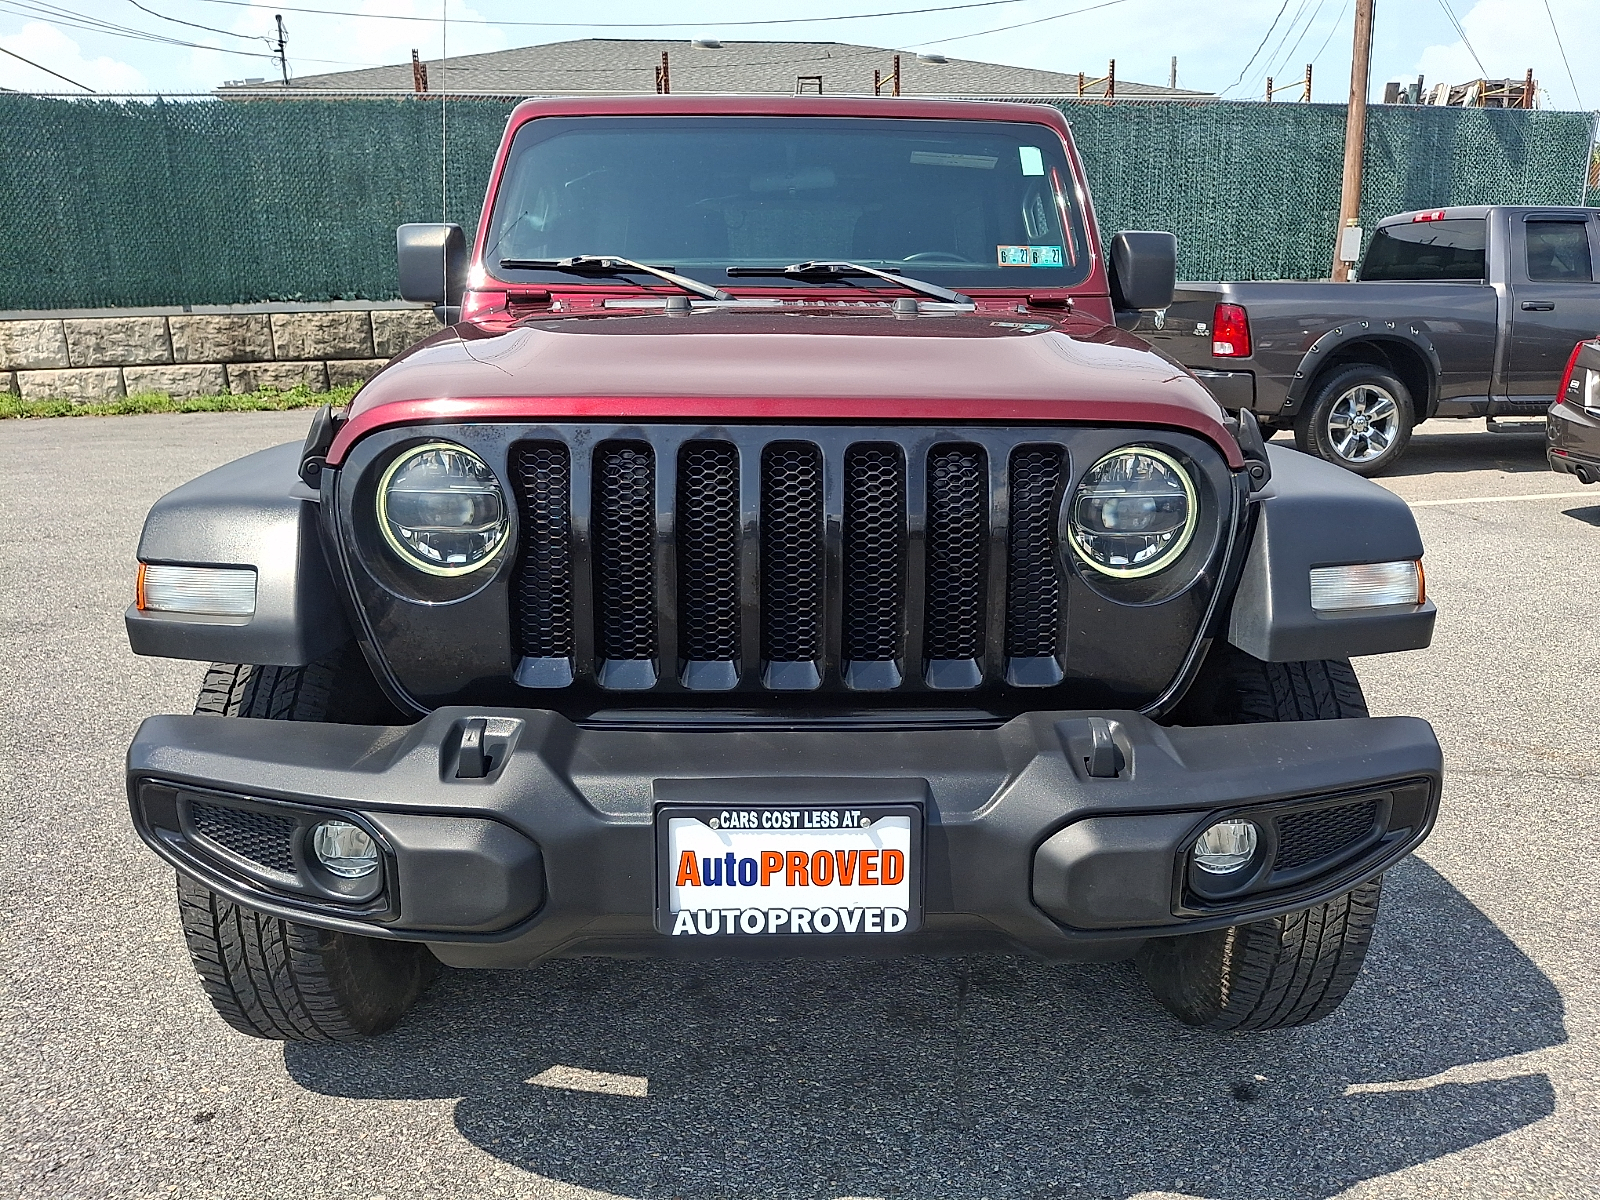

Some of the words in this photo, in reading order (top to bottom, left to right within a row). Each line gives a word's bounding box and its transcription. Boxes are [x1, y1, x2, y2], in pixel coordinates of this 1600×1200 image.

[720, 811, 758, 828] CARS
[761, 812, 800, 828] COST
[804, 811, 838, 828] LESS
[842, 811, 861, 828] AT
[676, 849, 905, 887] AutoPROVED
[672, 907, 907, 936] AUTOPROVED
